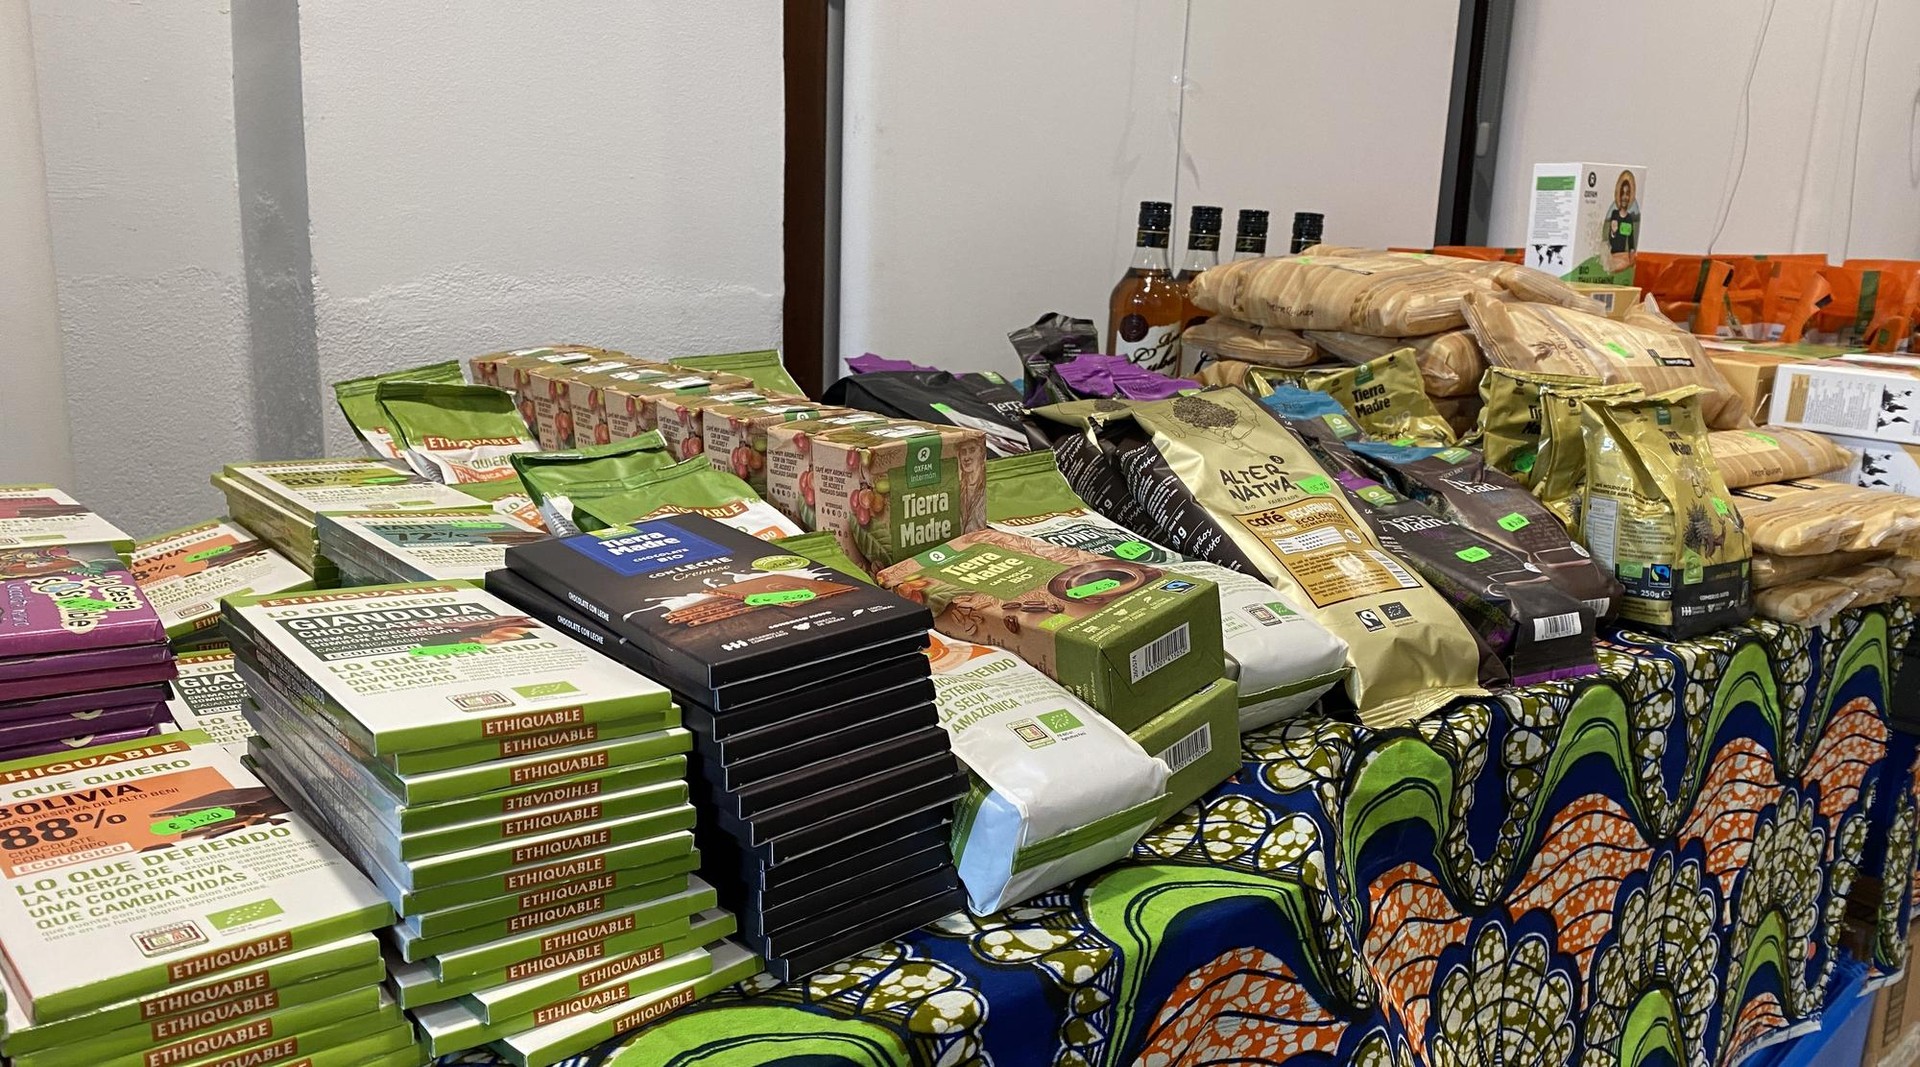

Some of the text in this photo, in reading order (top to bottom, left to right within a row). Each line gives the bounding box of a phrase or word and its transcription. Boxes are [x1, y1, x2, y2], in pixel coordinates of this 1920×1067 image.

[1352, 383, 1386, 402] Tierra
[1354, 397, 1391, 418] Madre
[914, 463, 933, 474] OXFAM
[1219, 463, 1290, 486] ALTER
[1229, 475, 1297, 502] NATIVA
[902, 491, 949, 521] Tierra
[1001, 509, 1082, 527] ETHIQUALE
[1246, 511, 1287, 528] café
[597, 530, 666, 549] Tierra
[901, 517, 951, 549] Madre
[1048, 528, 1102, 548] CONG
[1179, 525, 1188, 539] g
[132, 548, 189, 568] LIVIA
[607, 537, 681, 556] Madre
[632, 548, 690, 563] CHOCOLATE
[656, 554, 685, 563] BIO
[1202, 534, 1222, 561] justo
[648, 557, 733, 579] CON LECHE
[940, 552, 1002, 577] Tierra
[958, 557, 1025, 586] Madre
[1008, 573, 1034, 585] BIO
[266, 585, 451, 607] ETHIQUABLE
[266, 596, 457, 619] LO QUE QUIERO
[568, 592, 610, 623] CHOCOLATE CON LECHE
[1640, 589, 1660, 599] 250g
[287, 602, 488, 631] GIANDUJA
[297, 613, 496, 639] CHOCOLATE NEGRO
[557, 615, 604, 645] CHOCOLATE CON LECHE
[305, 634, 351, 645] CREMA
[353, 632, 368, 640] DE
[316, 644, 354, 653] CACAO
[374, 634, 391, 642] DE
[328, 662, 364, 674] LO
[371, 654, 426, 668] QUE
[337, 660, 452, 680] LAS TIERRAS
[345, 667, 449, 687] OLVIDADAS
[352, 674, 457, 694] DEL CACAO
[940, 691, 993, 724] LA SELVA
[950, 697, 1022, 734] AMAZÓNICA
[485, 709, 581, 736] ETHIQUABLE
[503, 726, 595, 754] ETHIQUABLE
[0, 743, 183, 782] HIQUABLE
[513, 753, 606, 783] ETHIQUABLE
[12, 759, 192, 799] QUE QUIERO
[34, 787, 179, 820] RESERVA DEL ALTO BENI
[506, 781, 599, 810] ETHIQUABLE
[0, 808, 127, 851] 88%
[506, 805, 599, 835] ETHIQUABLE
[8, 836, 96, 859] CHOCOLATE
[12, 840, 108, 866] CON CUERPO
[18, 845, 126, 873] ECOLÓGICO
[515, 831, 608, 862] ETHIQUABLE
[15, 826, 291, 897] LO QUE DEFIENDO
[508, 858, 603, 889] ETHIQUABLE
[22, 865, 174, 907] LA FUERZA DE
[28, 863, 233, 918] UNA COOPERATIVA
[522, 875, 614, 909] ETHIQUABLE
[36, 872, 248, 930] QUE CAMBIA VIDAS
[510, 897, 602, 931] ETHIQUABLE
[544, 916, 633, 951] ETHIQUABLE
[172, 935, 289, 980] ETHIQUABLE
[509, 944, 602, 980] ETHIQUABLE
[581, 947, 662, 987] ETHIQUABLE
[145, 973, 265, 1017] ETHIQUABLE
[536, 986, 627, 1024] ETHIQUABLE
[156, 992, 276, 1038] ETHIQUABLE
[615, 990, 693, 1033] ETHIQUABLE
[149, 1022, 269, 1067] ETHIQUABLE
